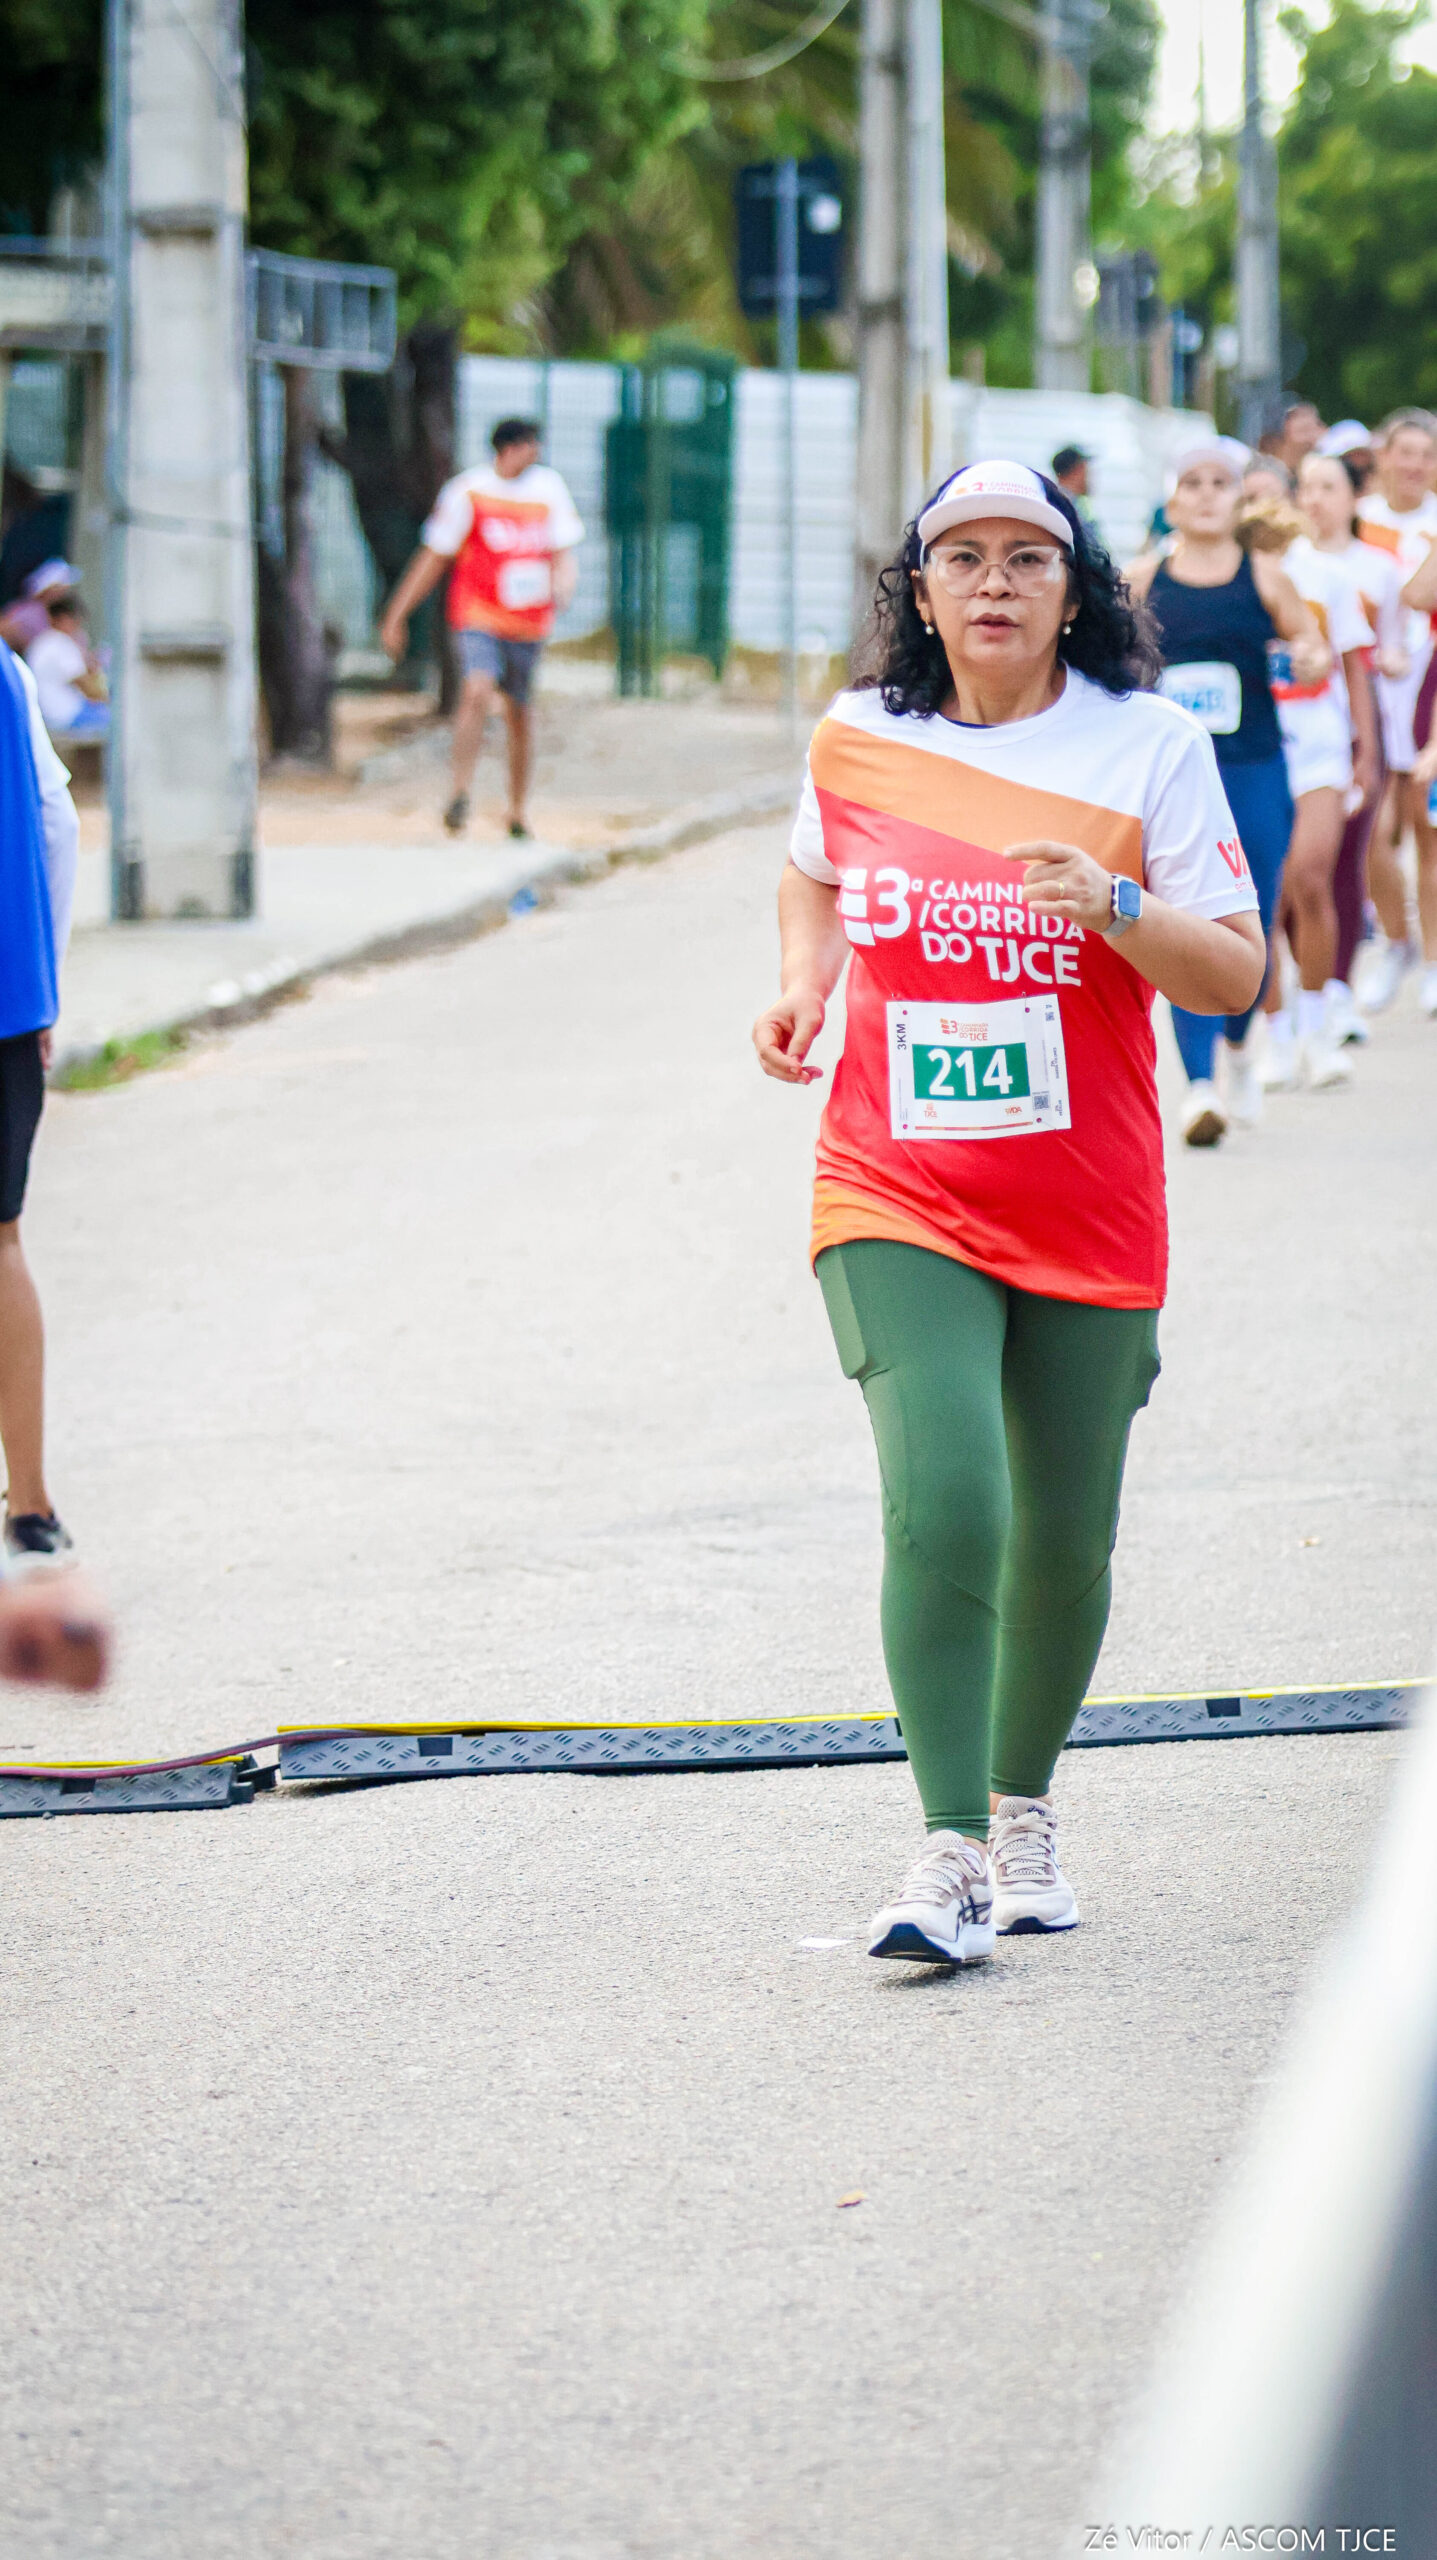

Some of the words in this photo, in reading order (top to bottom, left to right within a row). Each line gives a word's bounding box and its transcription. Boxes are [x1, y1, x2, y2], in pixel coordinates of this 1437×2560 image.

[920, 930, 972, 963] DO
[976, 936, 1082, 987] TJCE
[896, 1023, 907, 1051] 3KM
[969, 1032, 989, 1041] TJCE
[927, 1047, 1014, 1097] 214
